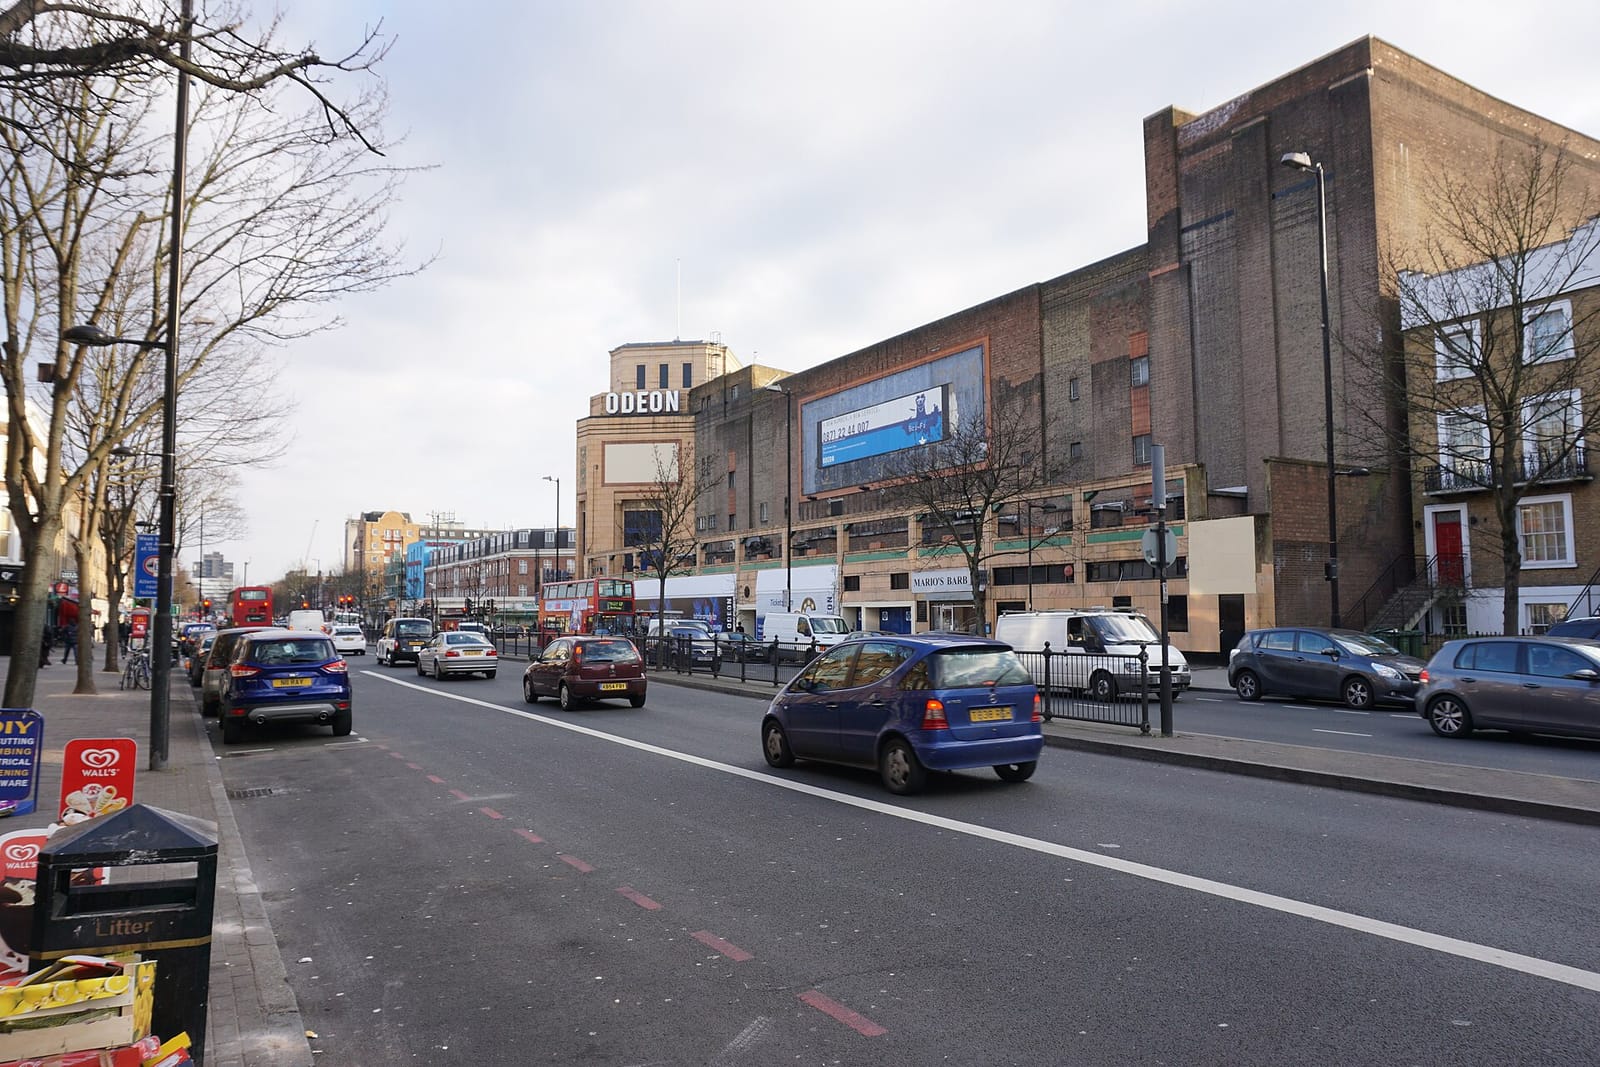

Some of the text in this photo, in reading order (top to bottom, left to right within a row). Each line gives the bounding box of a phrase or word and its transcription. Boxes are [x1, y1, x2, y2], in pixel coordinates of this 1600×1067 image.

[605, 390, 679, 414] ODEON
[837, 427, 846, 438] 22
[847, 424, 855, 434] 44
[857, 421, 869, 432] 007
[913, 575, 968, 588] MARIO'S BARB
[81, 768, 117, 777] WALL'S
[5, 861, 39, 869] WALL'S
[96, 918, 154, 936] Litter
